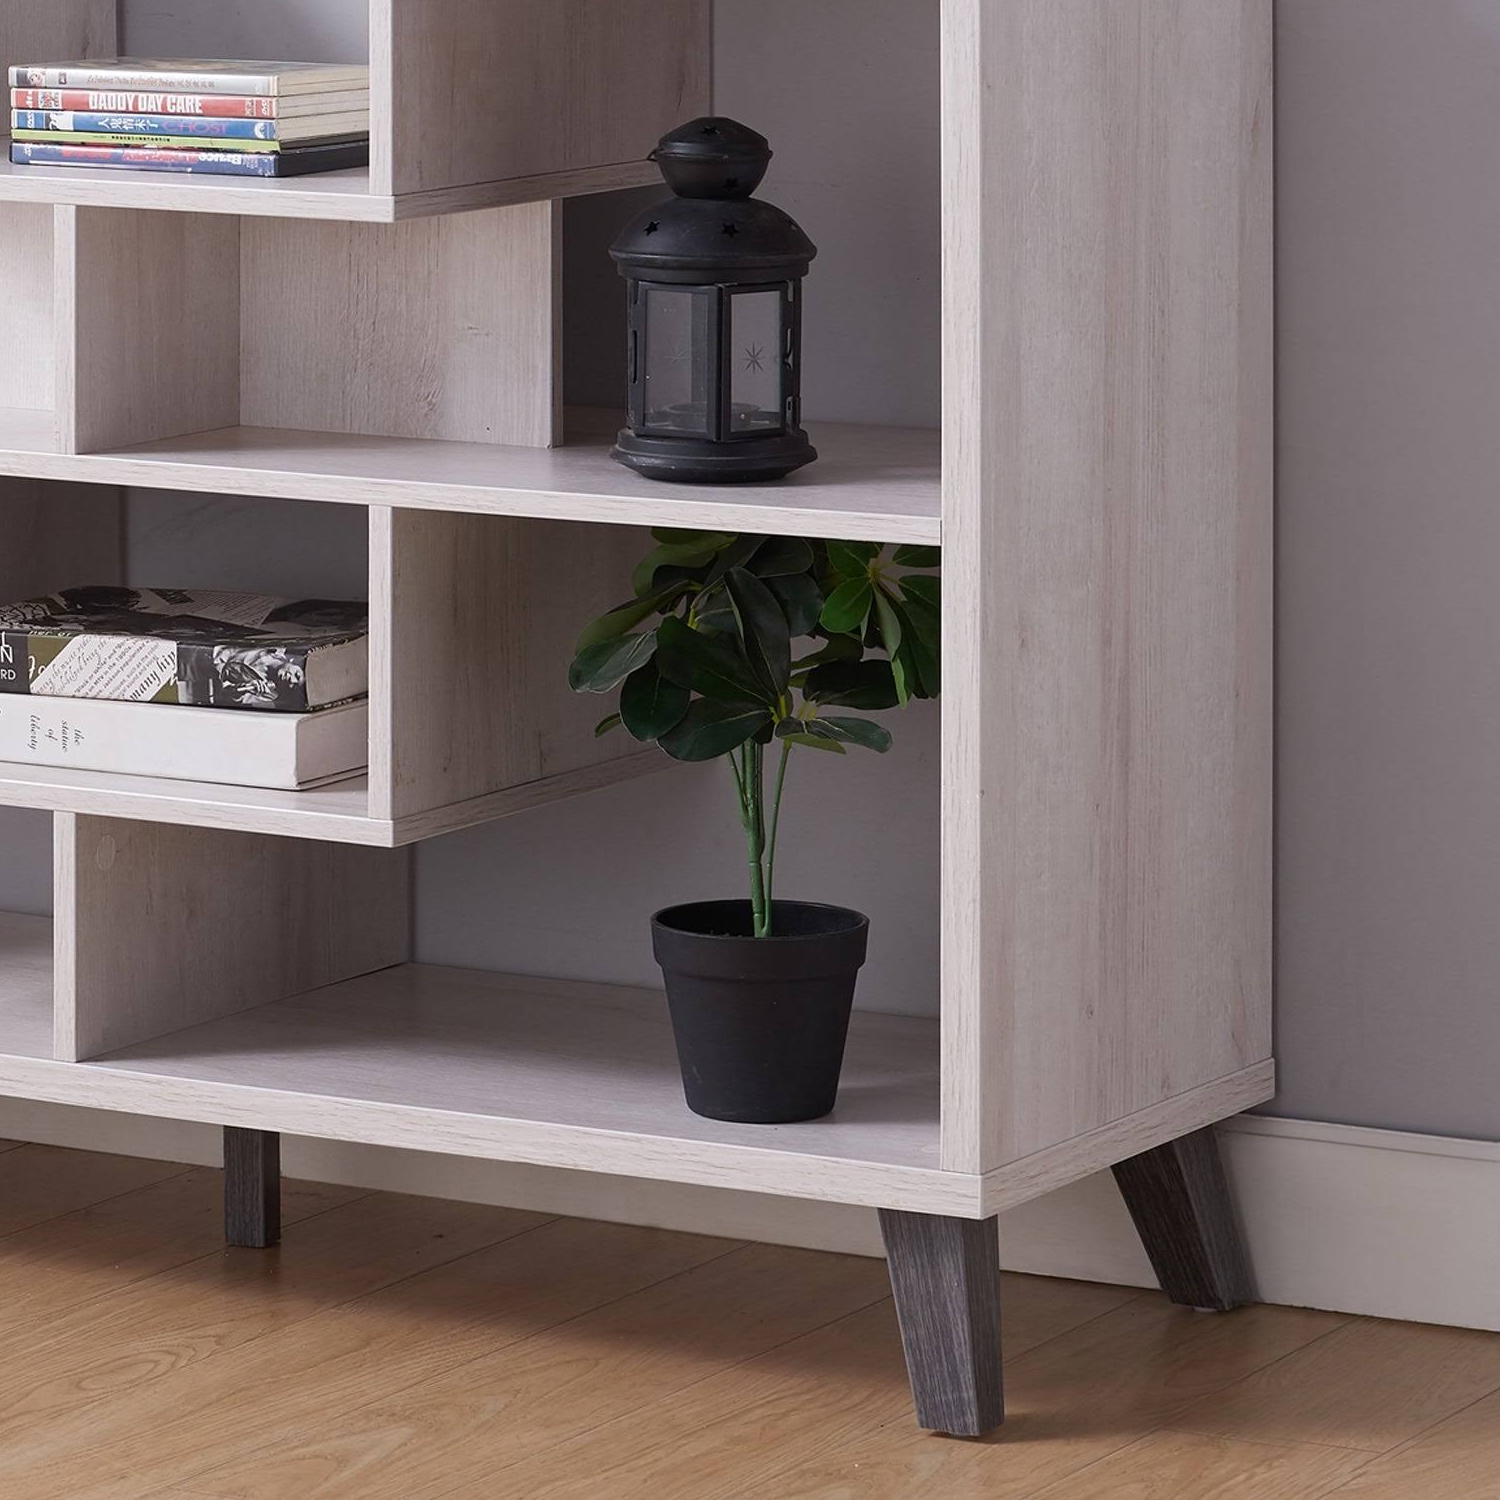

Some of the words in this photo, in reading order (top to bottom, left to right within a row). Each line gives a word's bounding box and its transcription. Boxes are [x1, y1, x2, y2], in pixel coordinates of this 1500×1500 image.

[89, 92, 134, 111] DADDY
[137, 93, 163, 112] DAY
[166, 95, 203, 114] CARE
[129, 670, 161, 700] many
[27, 714, 41, 749] liberty
[44, 728, 58, 741] of
[61, 719, 69, 753] statue
[74, 729, 85, 746] the
